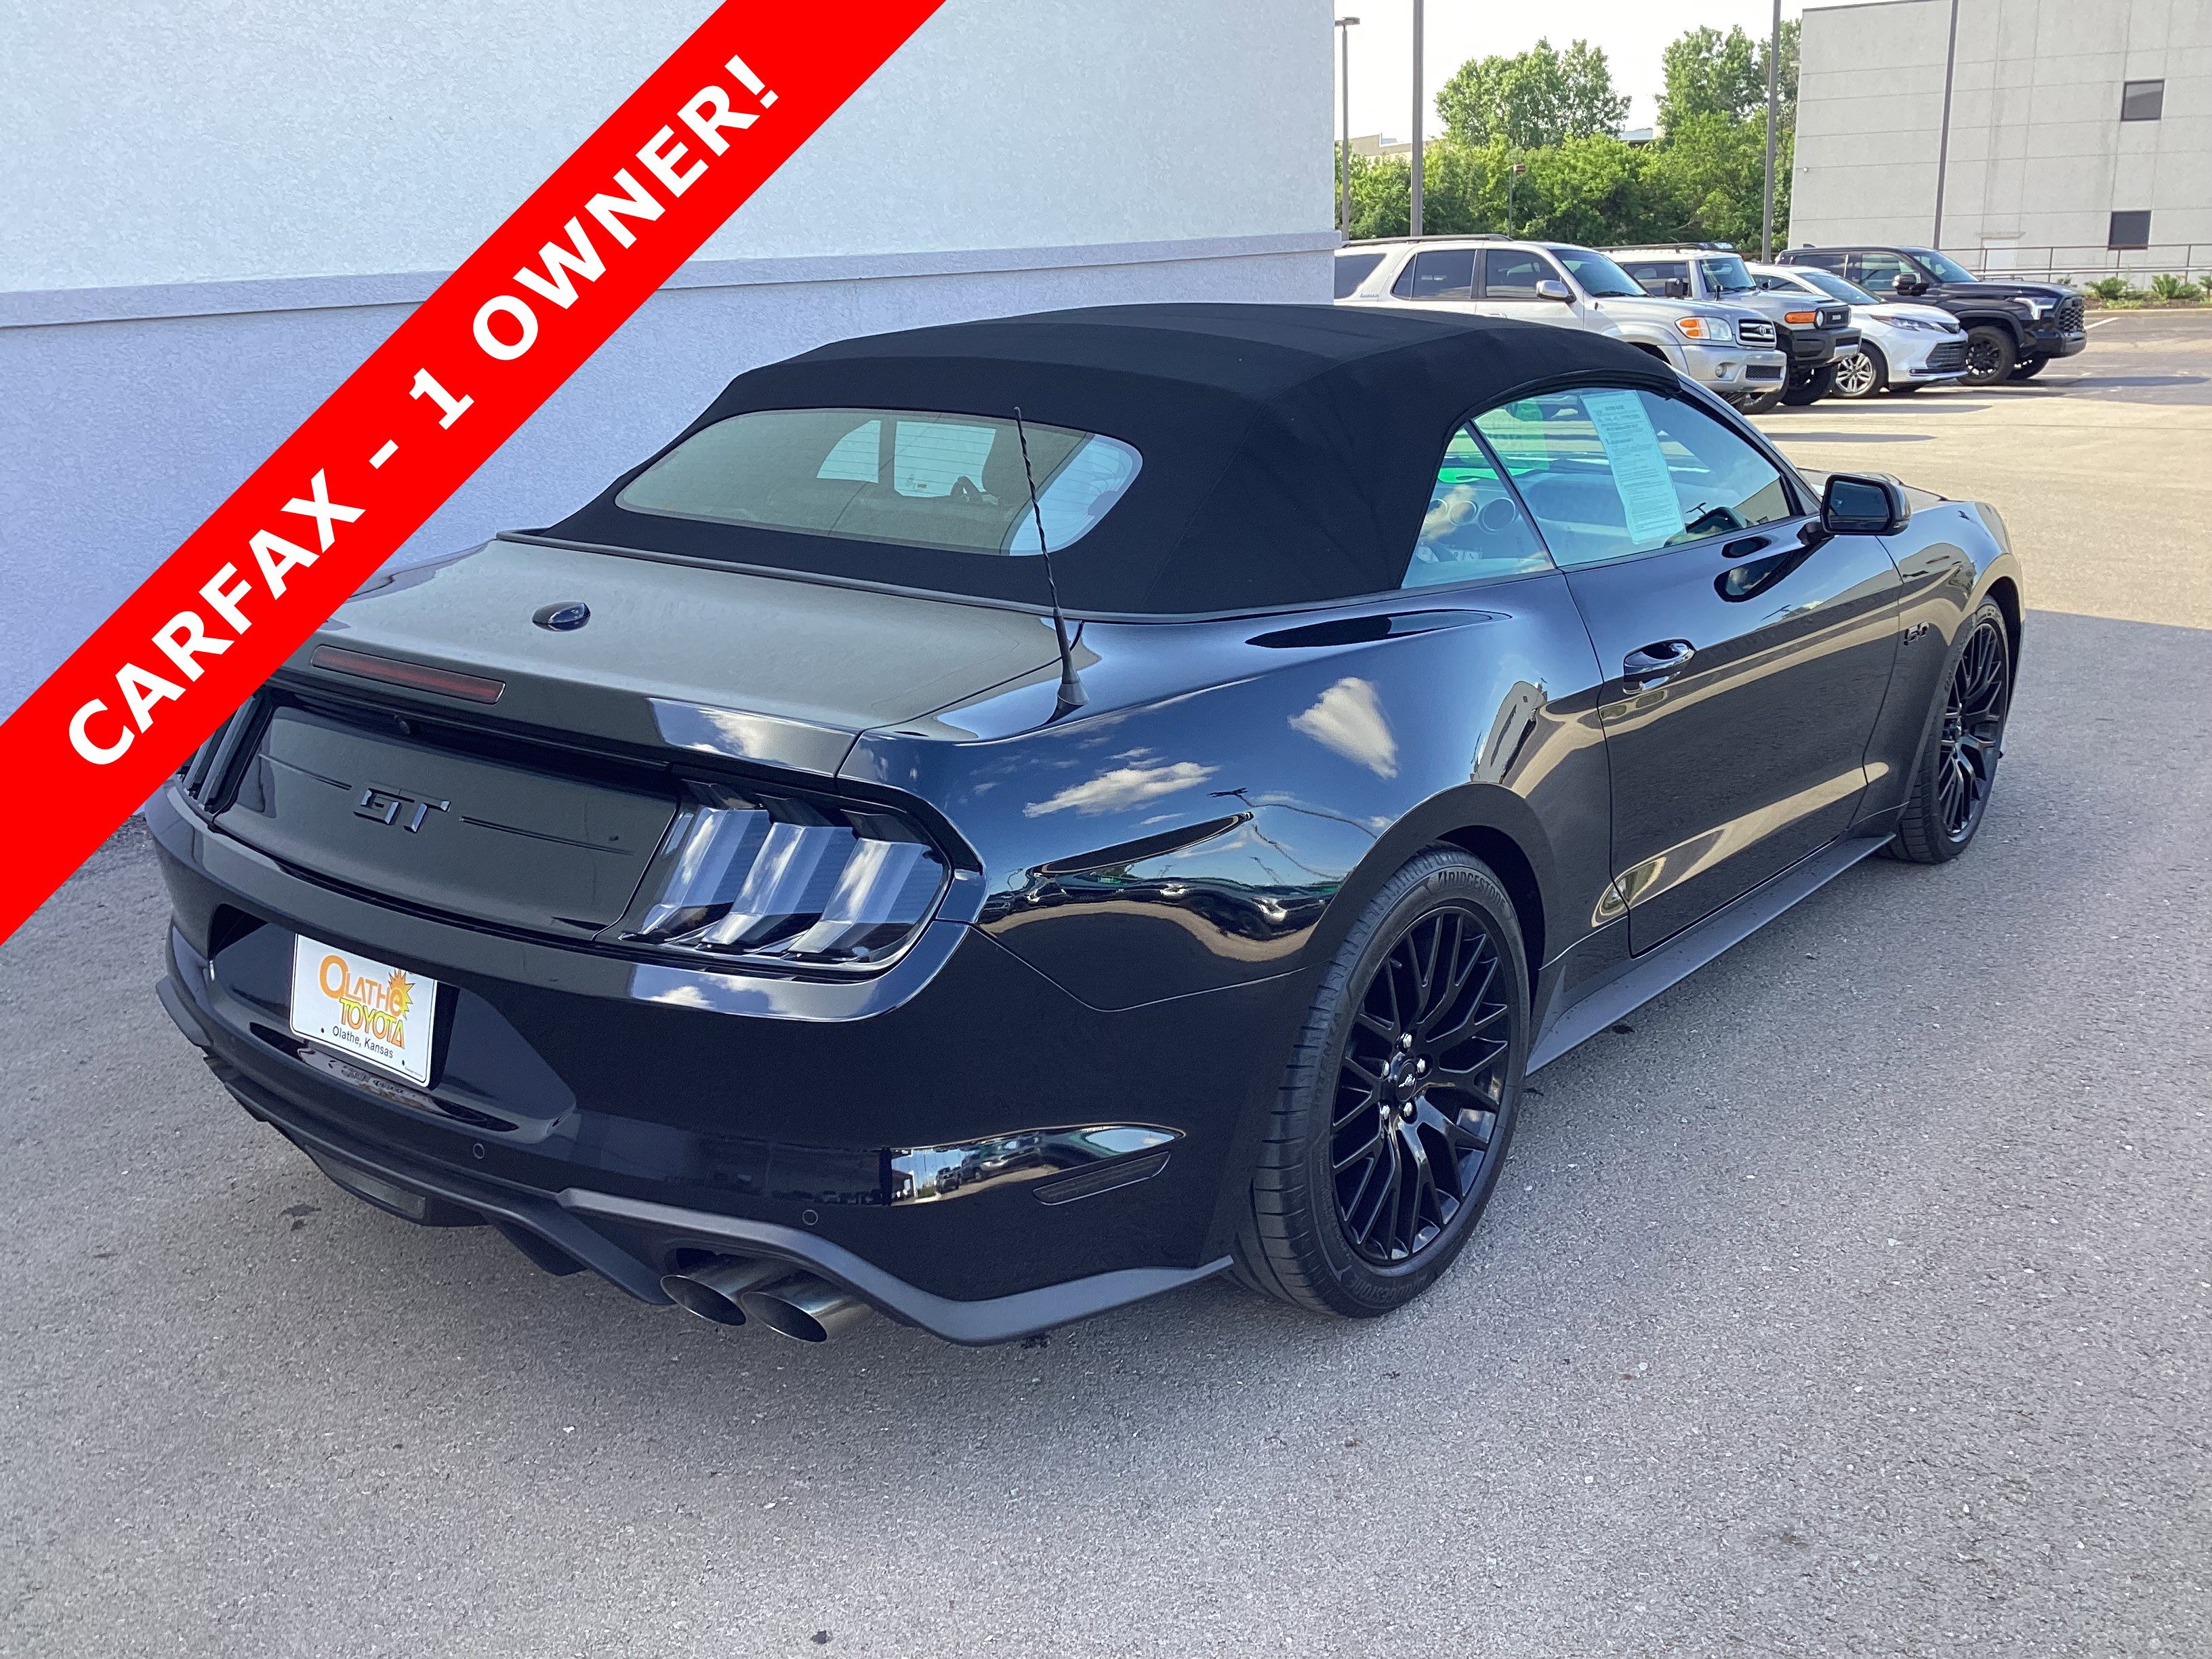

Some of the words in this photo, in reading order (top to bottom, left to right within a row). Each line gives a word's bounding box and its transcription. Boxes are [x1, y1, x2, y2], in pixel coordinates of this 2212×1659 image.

[352, 783, 452, 834] GT
[1437, 870, 1509, 909] BRIDGESTONE
[332, 1025, 362, 1048] Olathe,
[363, 1037, 394, 1059] Kansas
[340, 997, 406, 1049] TOYOTA
